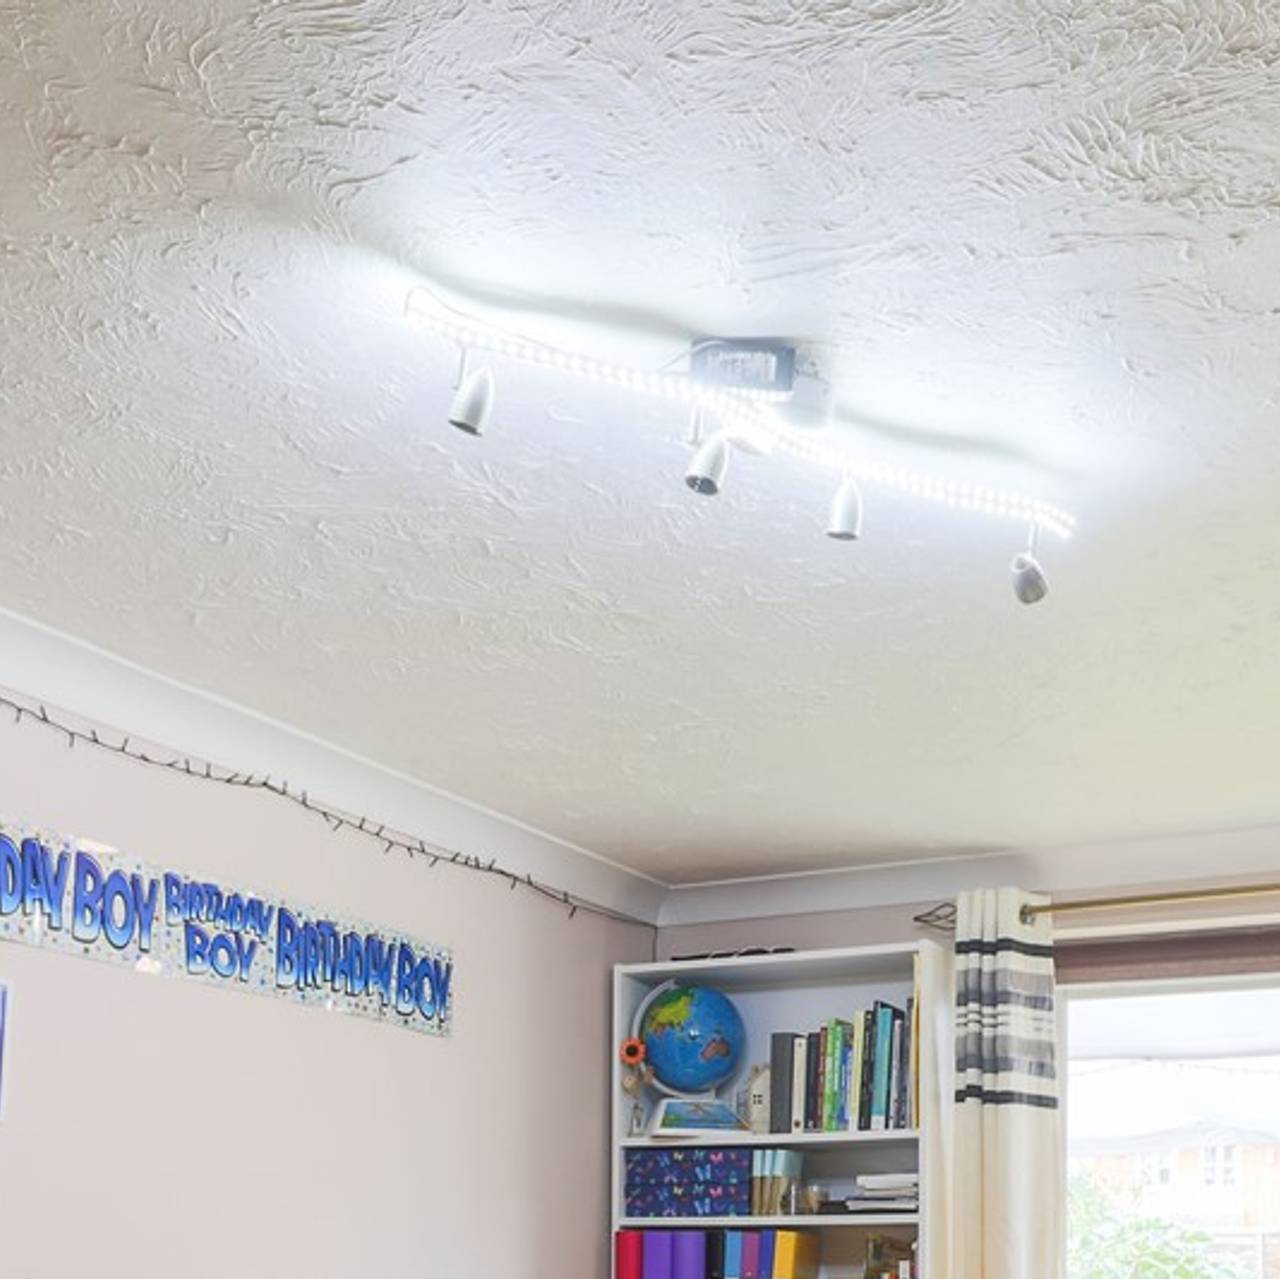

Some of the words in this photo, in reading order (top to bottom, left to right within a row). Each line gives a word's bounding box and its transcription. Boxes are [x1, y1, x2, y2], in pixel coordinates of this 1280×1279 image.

[72, 850, 159, 953] BOY
[163, 871, 274, 944] BIRTHDAY
[184, 921, 257, 982] BOY
[275, 906, 397, 1007] BIRTHDAY
[395, 940, 453, 1024] BOY
